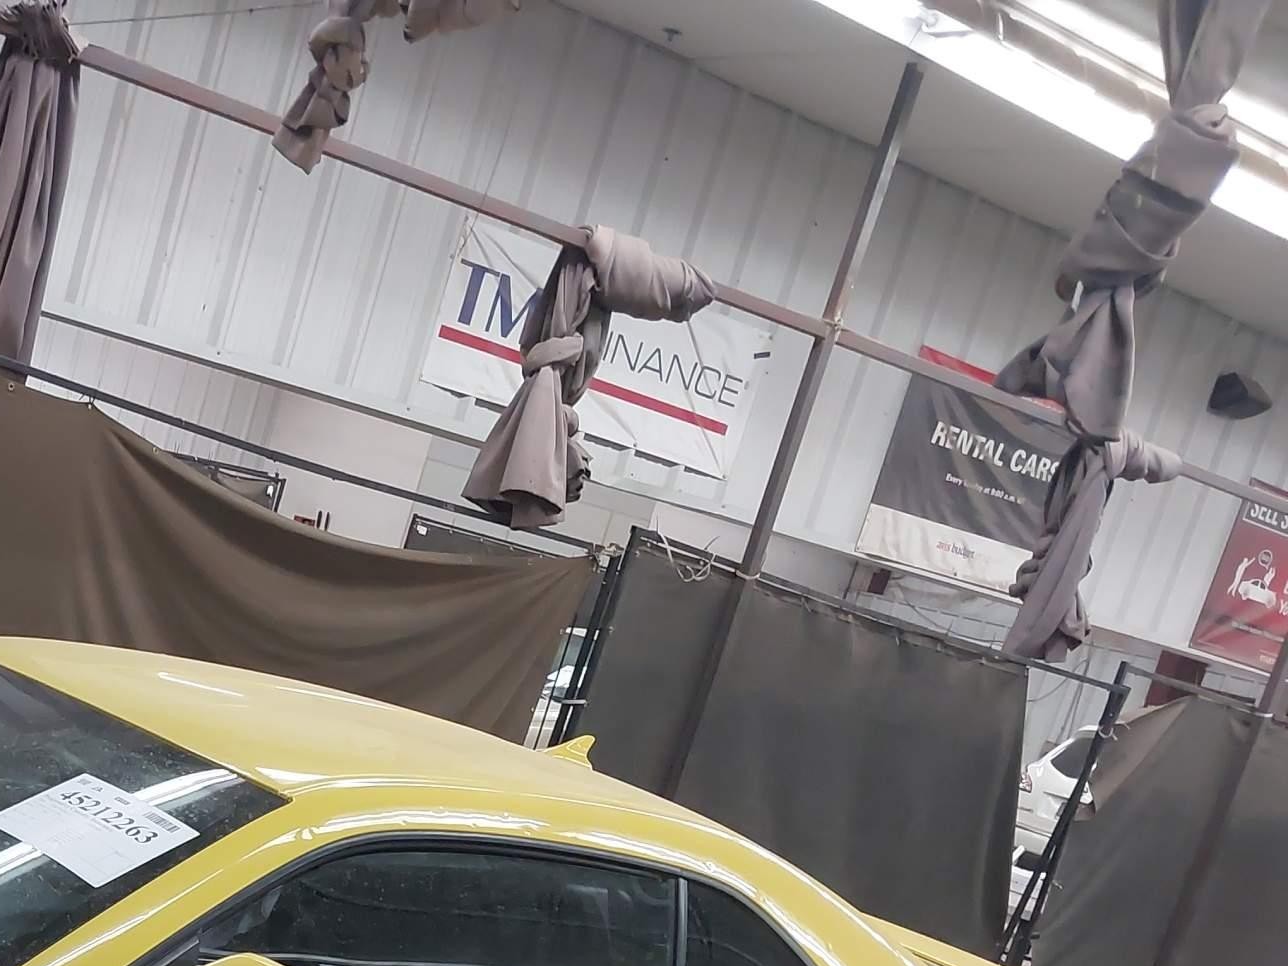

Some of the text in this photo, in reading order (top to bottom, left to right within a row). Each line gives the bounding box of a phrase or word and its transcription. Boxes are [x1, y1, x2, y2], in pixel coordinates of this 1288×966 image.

[603, 331, 743, 408] INANCE
[931, 421, 1005, 467] RENTAL
[59, 791, 158, 844] 45212263
